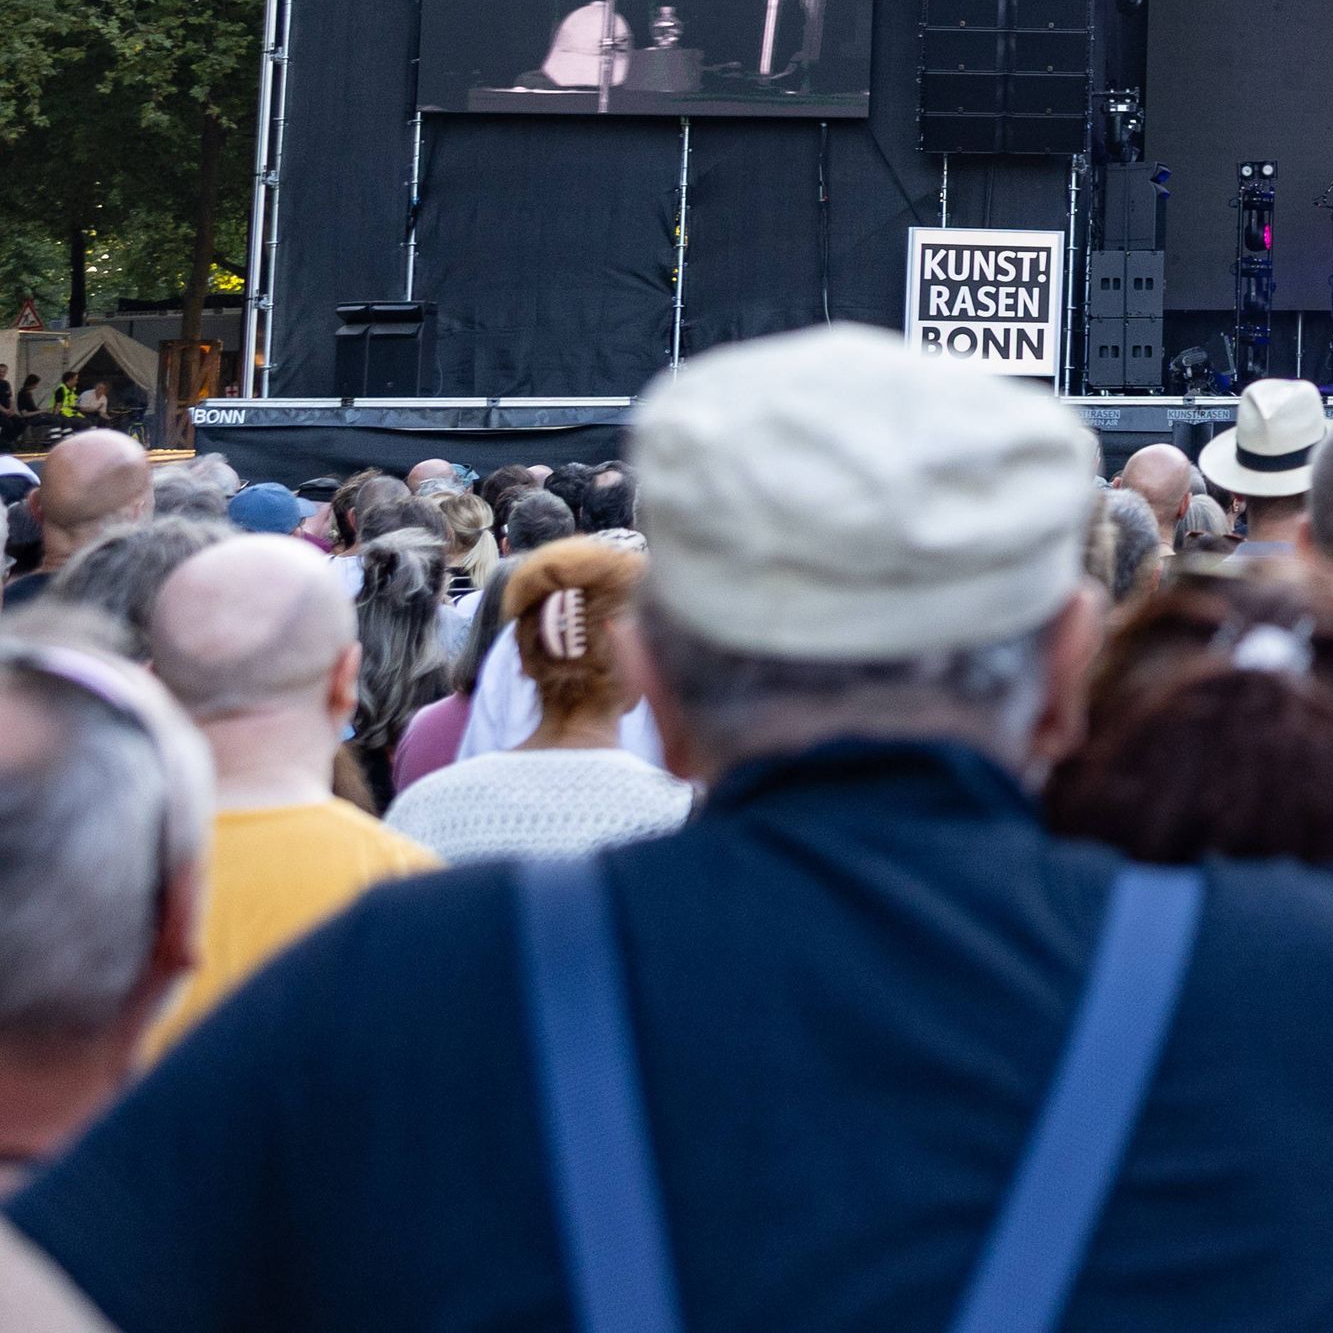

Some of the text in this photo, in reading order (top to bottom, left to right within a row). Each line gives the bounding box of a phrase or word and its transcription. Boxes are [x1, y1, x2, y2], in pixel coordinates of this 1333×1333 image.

[923, 248, 1048, 283] KUNST!
[929, 285, 1040, 318] RASEN
[921, 326, 1045, 360] BONN
[194, 408, 246, 424] BONN
